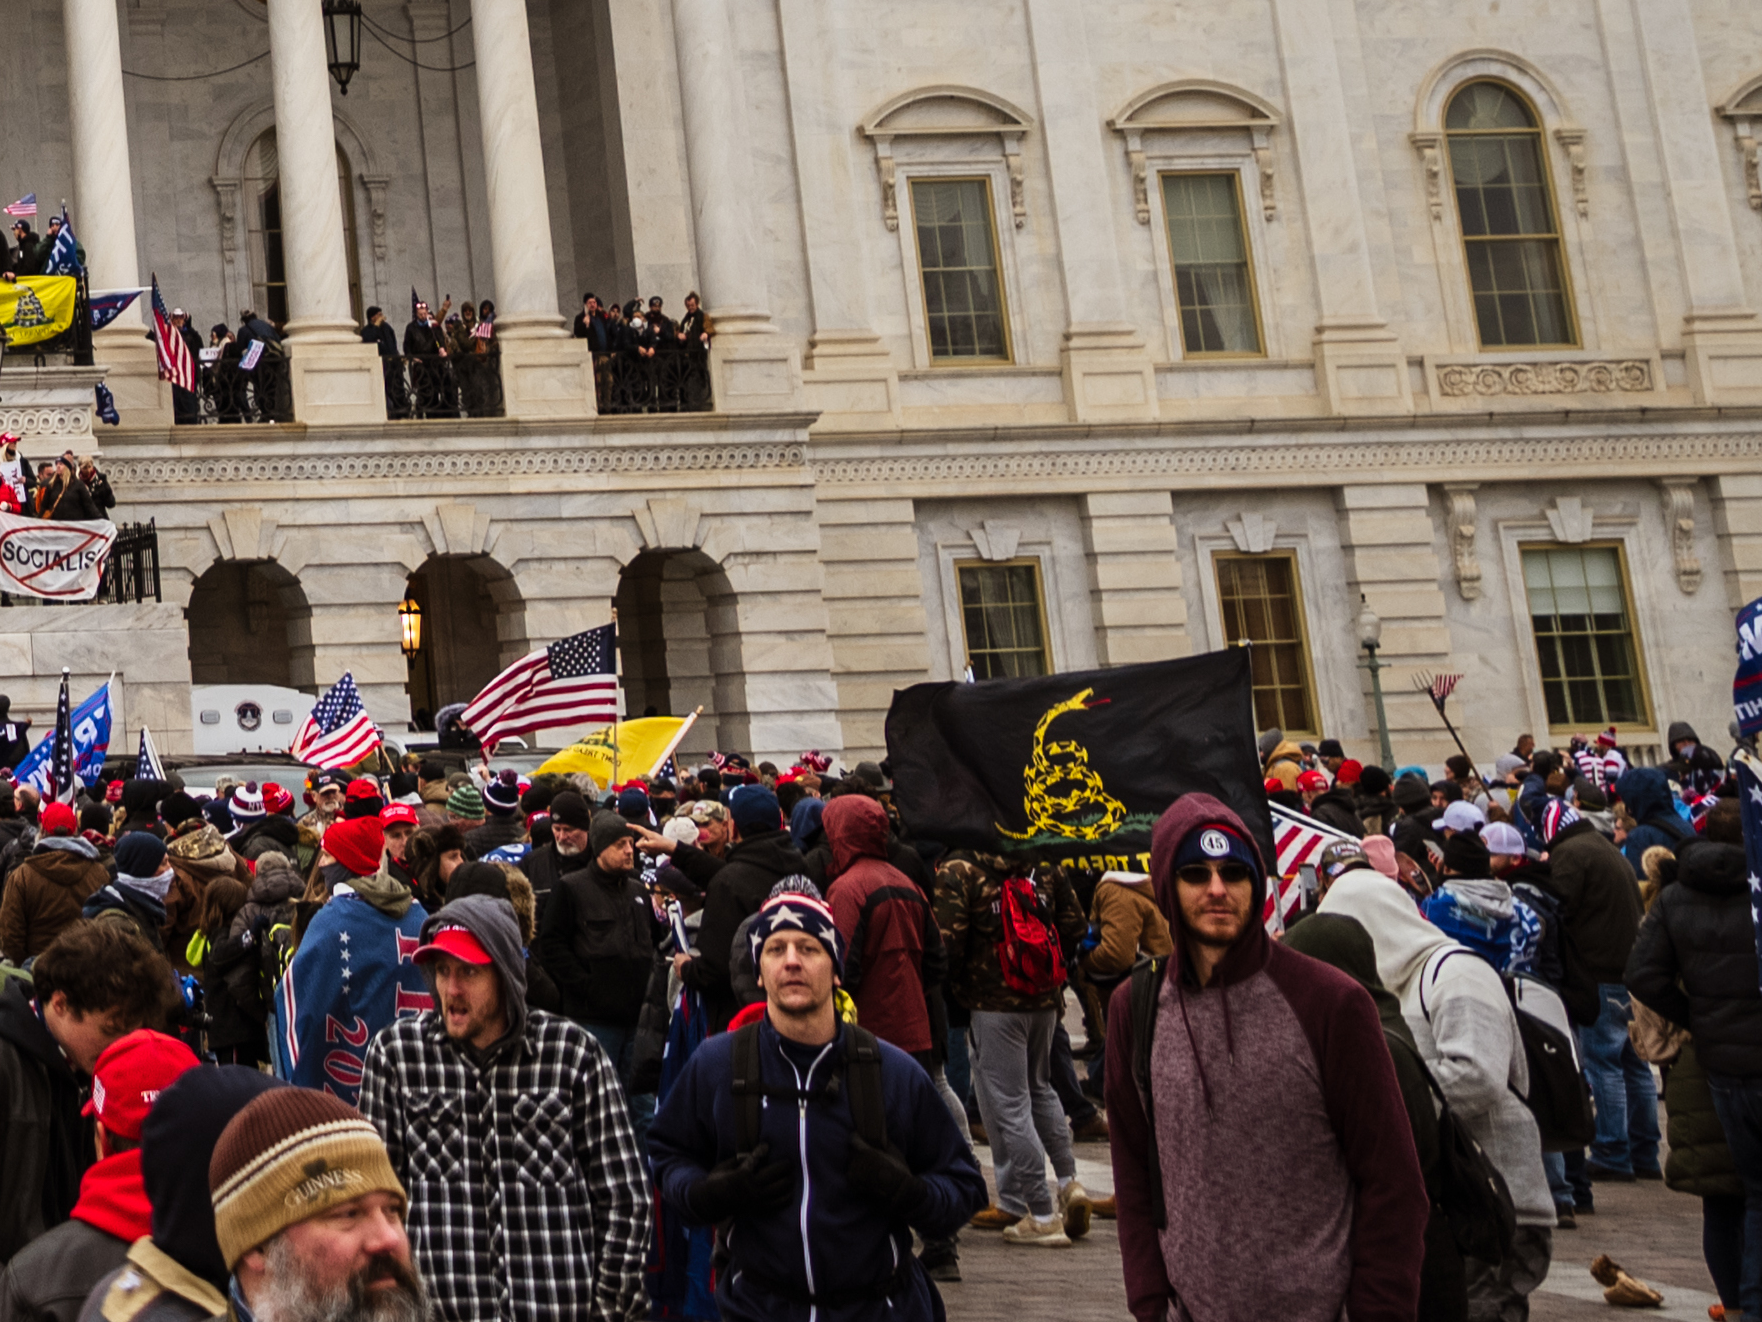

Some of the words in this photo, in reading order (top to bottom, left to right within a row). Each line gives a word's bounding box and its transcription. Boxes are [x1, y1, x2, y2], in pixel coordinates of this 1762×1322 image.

[2, 541, 102, 572] SOCIALIS
[1207, 836, 1224, 850] 45
[284, 1167, 365, 1209] GUINNESS
